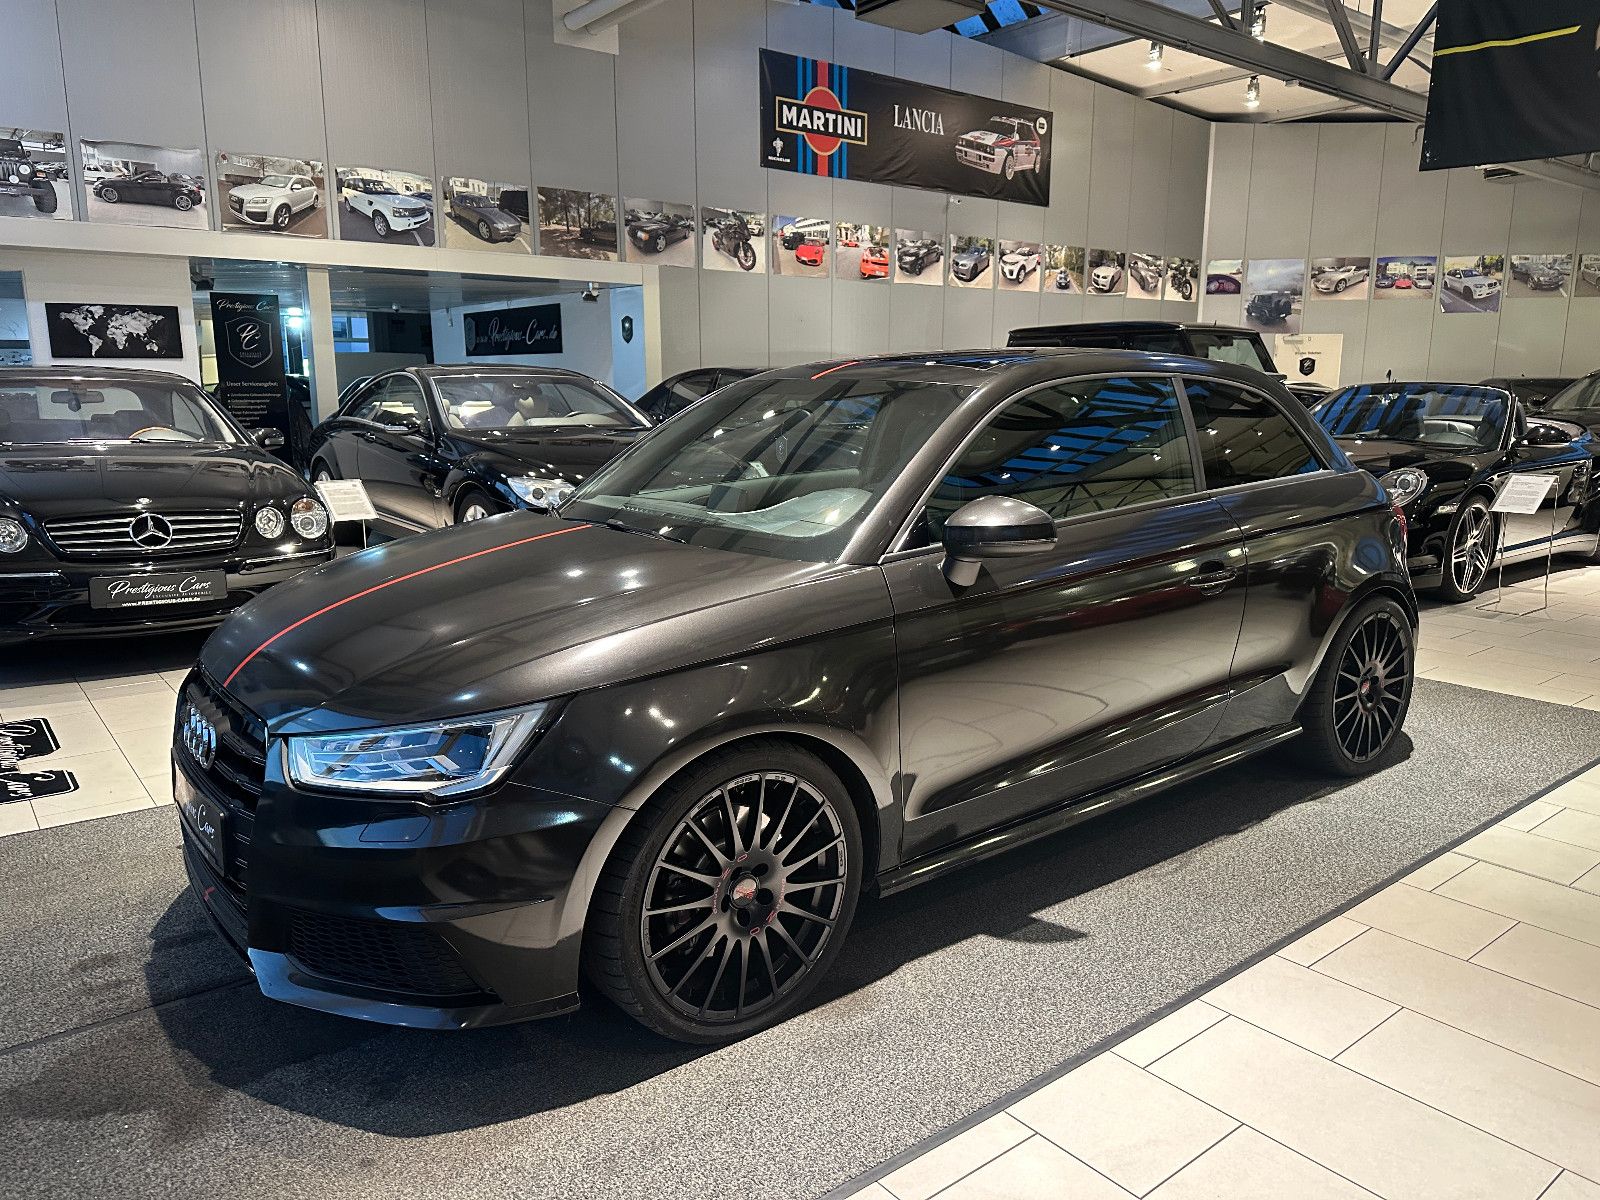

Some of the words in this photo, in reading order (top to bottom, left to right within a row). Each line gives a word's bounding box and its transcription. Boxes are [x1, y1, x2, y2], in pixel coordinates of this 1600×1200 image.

[782, 104, 862, 138] MARTINI
[893, 104, 945, 136] LANCIA
[107, 580, 177, 599] Prestigious
[178, 575, 212, 593] Cars
